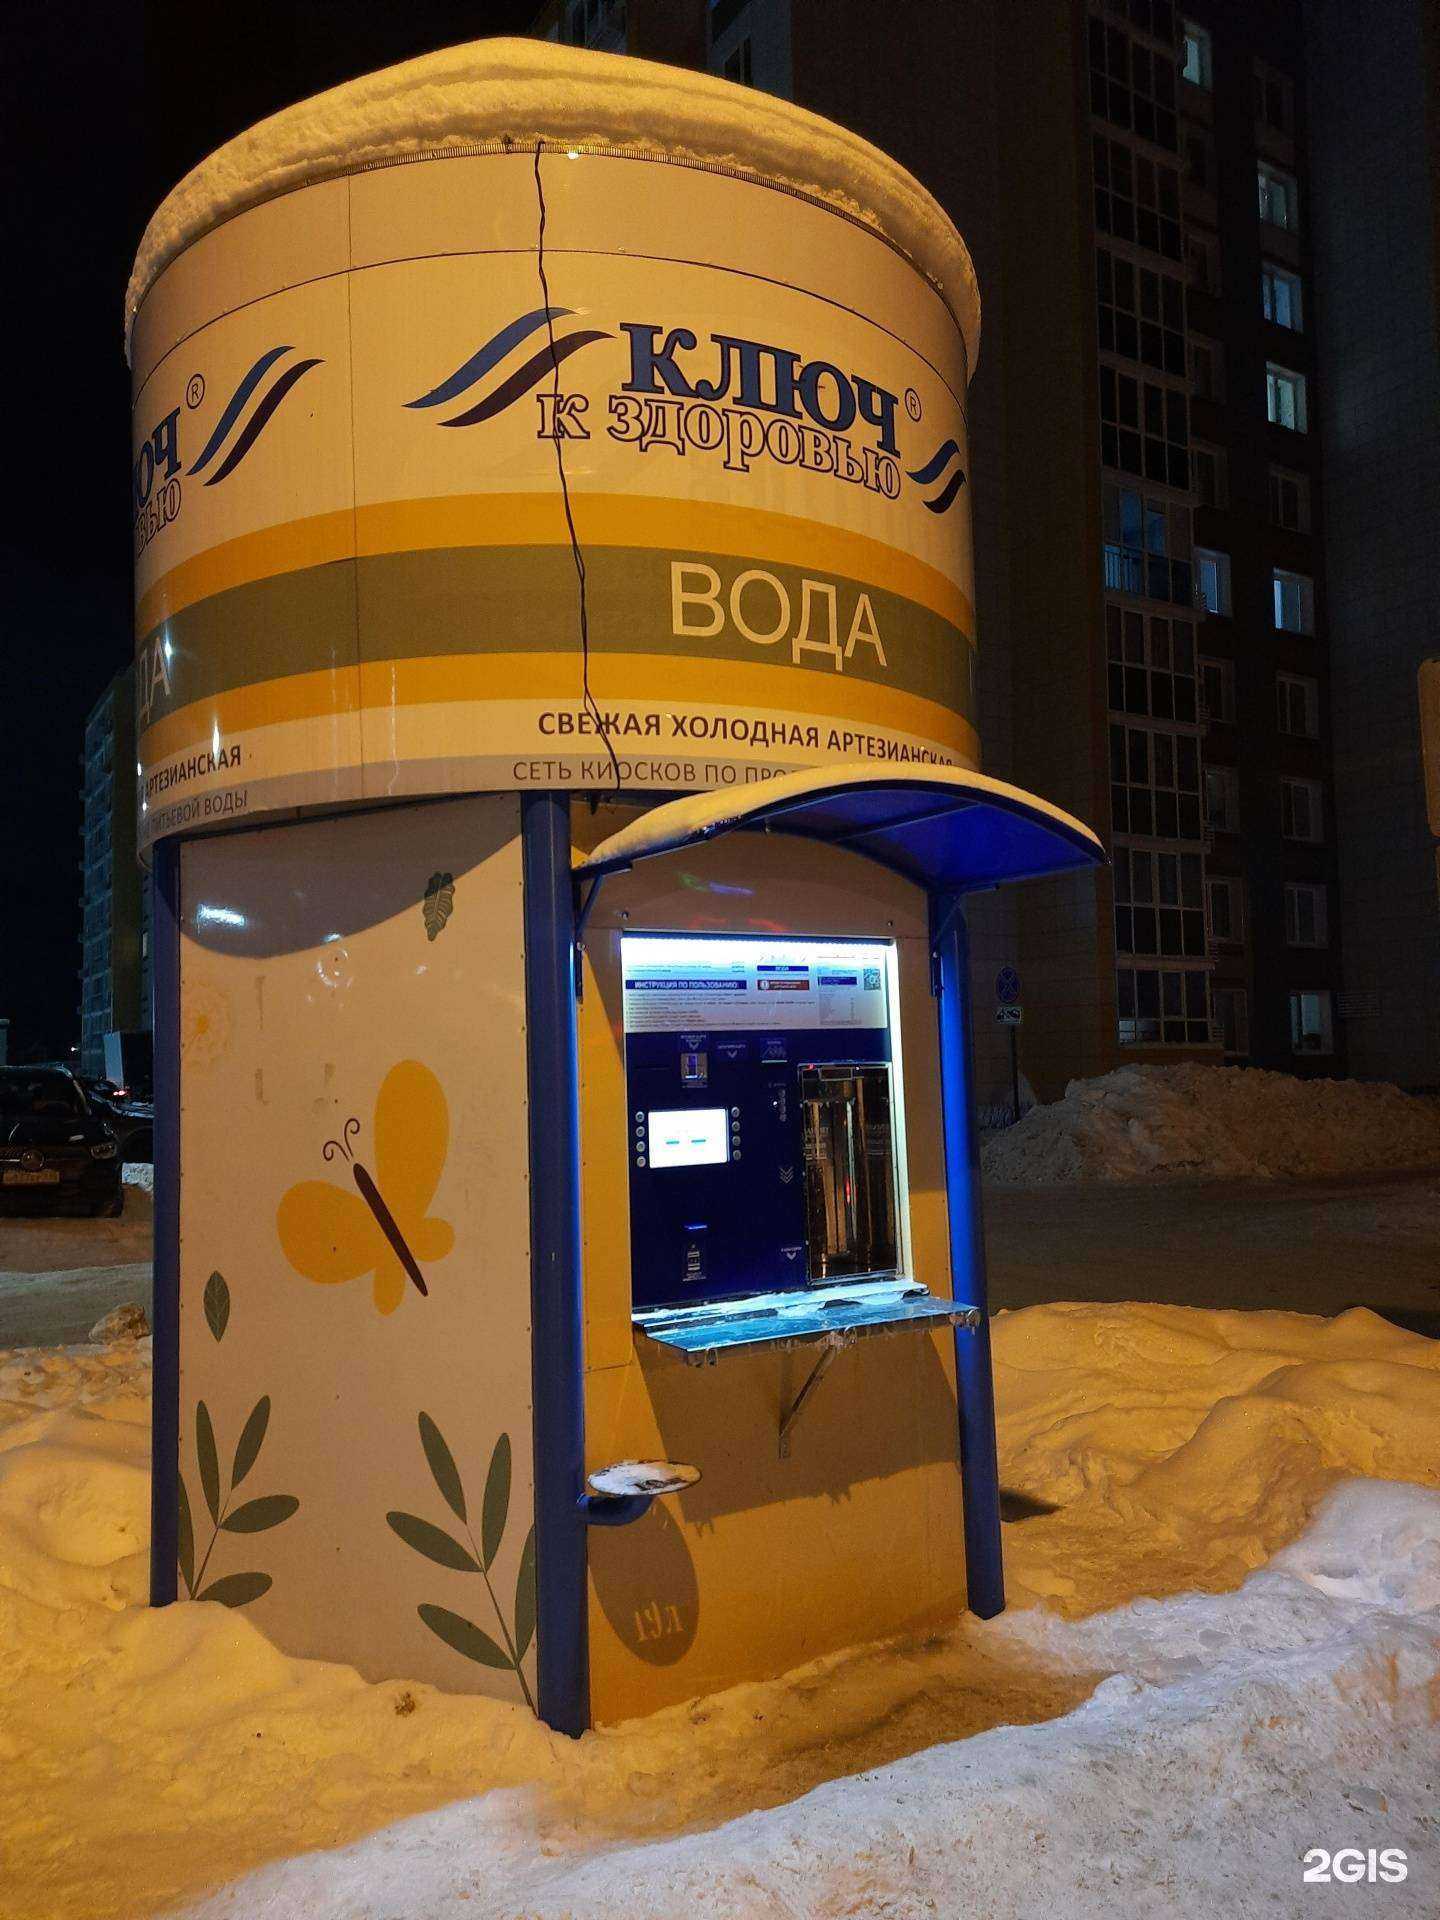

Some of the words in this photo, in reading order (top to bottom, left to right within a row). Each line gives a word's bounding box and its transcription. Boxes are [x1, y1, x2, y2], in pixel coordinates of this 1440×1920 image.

[620, 322, 901, 458] КЛЮЧ
[670, 561, 889, 673] ВОДА
[538, 712, 661, 736] СВЕЖАЯ
[672, 715, 819, 748] ХОЛОДНАЯ
[513, 761, 572, 780] СЕТЬ
[581, 761, 697, 782] КИОСКОВ
[705, 764, 737, 784] ПО
[205, 789, 248, 816] ВОДЫ
